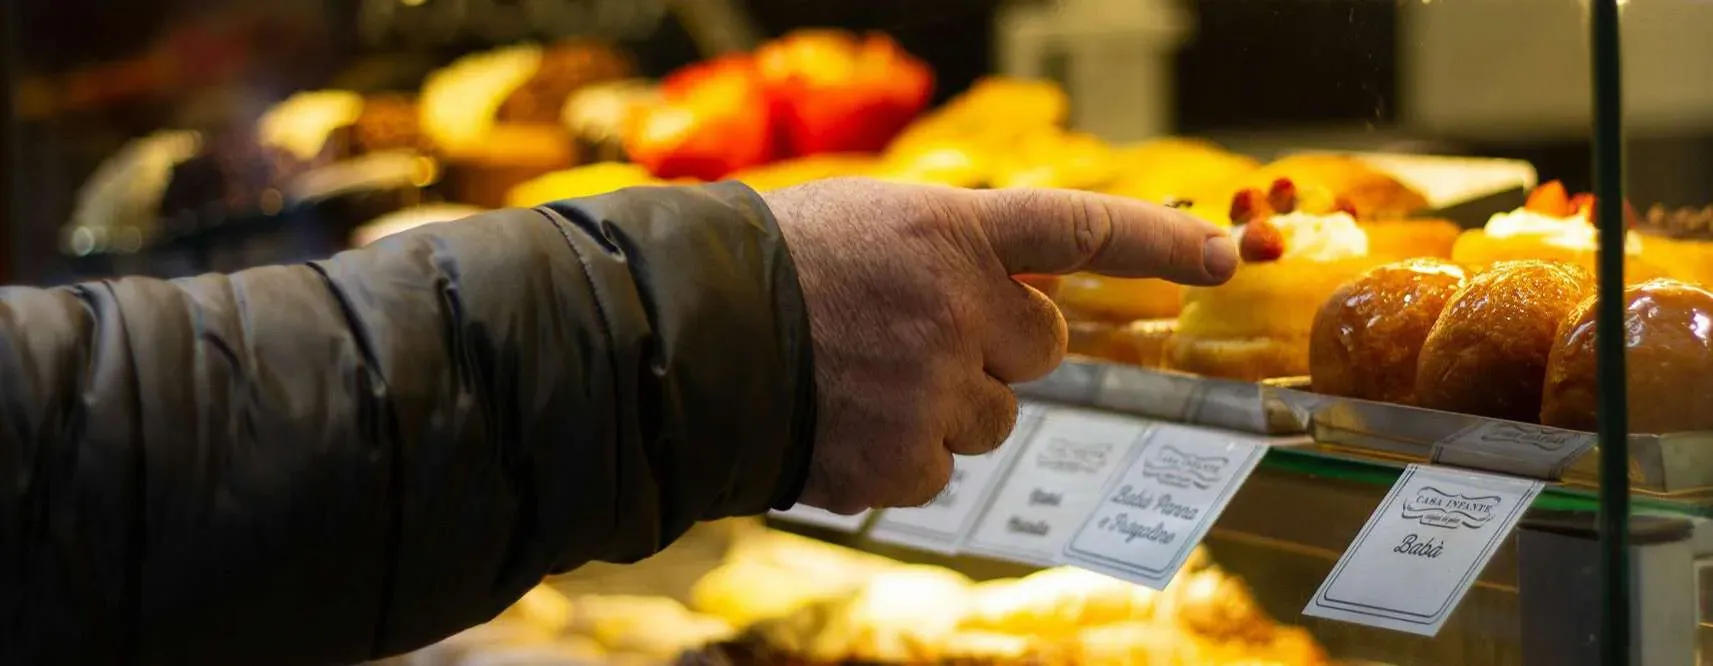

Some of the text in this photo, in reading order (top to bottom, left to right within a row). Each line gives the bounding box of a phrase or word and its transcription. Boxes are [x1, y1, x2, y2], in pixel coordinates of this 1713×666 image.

[1415, 494, 1494, 514] CASA INFANTE
[1393, 533, 1444, 559] Babà
